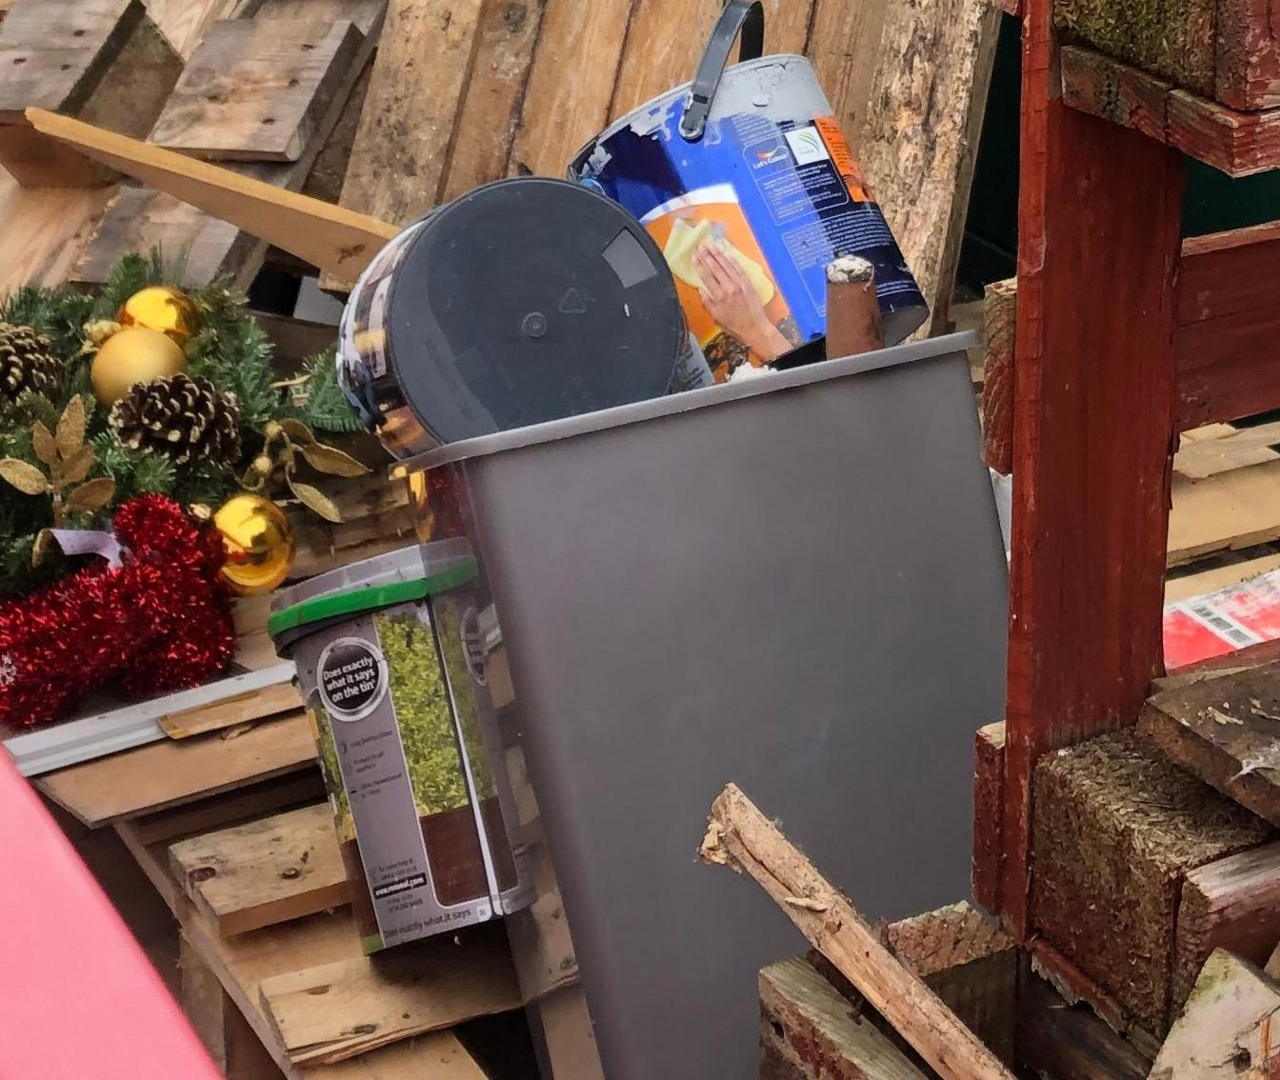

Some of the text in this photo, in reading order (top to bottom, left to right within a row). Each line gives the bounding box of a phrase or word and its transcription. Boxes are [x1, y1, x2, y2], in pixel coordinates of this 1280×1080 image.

[343, 657, 373, 672] exactly
[327, 669, 375, 690] what it says
[332, 692, 344, 703] on
[343, 686, 360, 698] the
[452, 909, 472, 921] says
